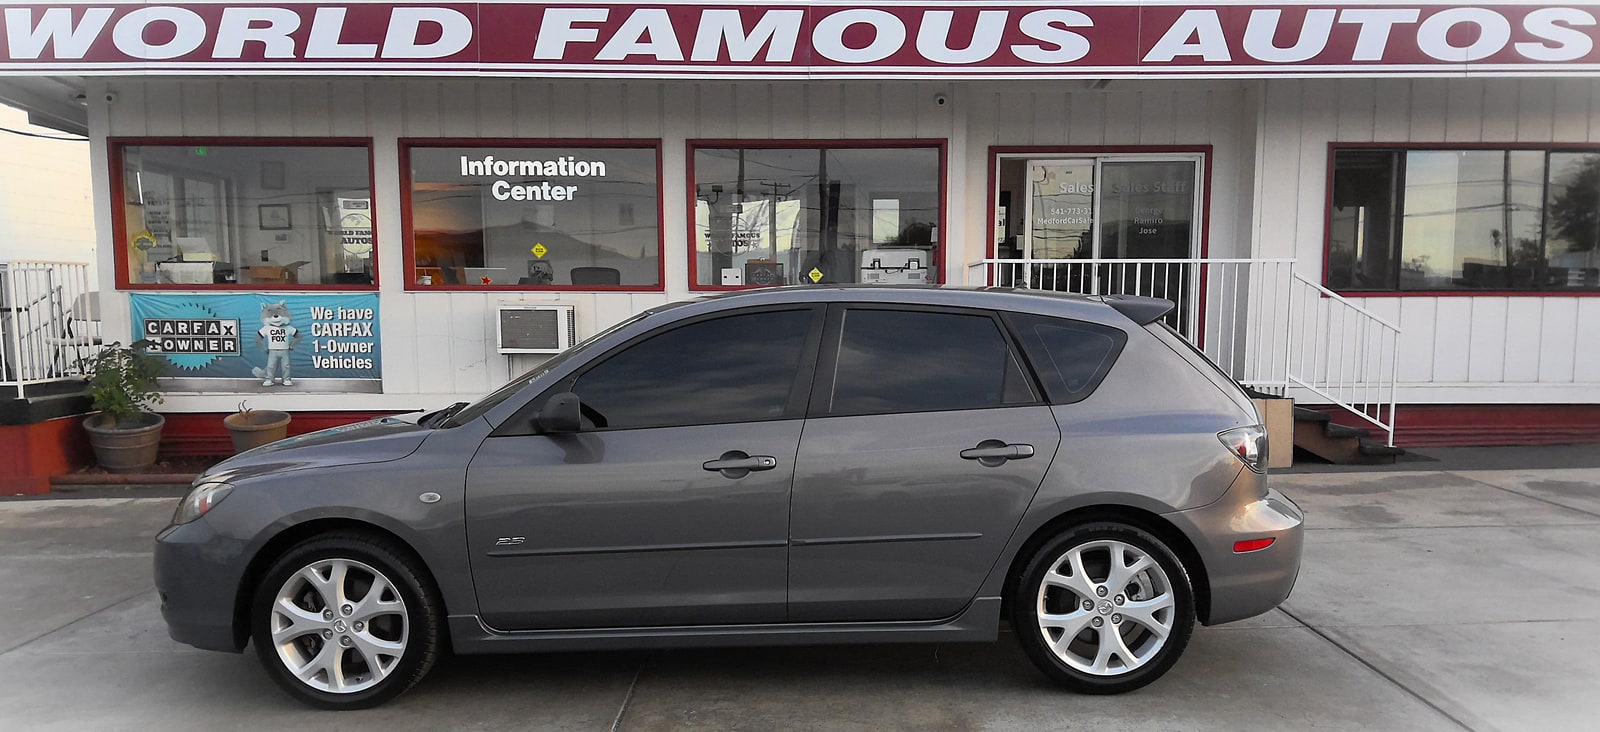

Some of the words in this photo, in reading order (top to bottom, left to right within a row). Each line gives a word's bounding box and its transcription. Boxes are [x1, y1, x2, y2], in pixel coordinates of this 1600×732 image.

[5, 6, 474, 60] WORLD
[533, 7, 1093, 64] FAMOUS
[1141, 7, 1598, 63] AUTOS
[460, 155, 606, 177] Information
[492, 180, 578, 201] Center
[1059, 181, 1095, 194] Sales
[1111, 181, 1149, 194] Sales
[1153, 180, 1186, 193] Staff
[1134, 217, 1163, 225] Ramiro
[1138, 227, 1157, 235] Jose
[310, 306, 336, 320] We
[338, 306, 374, 320] have
[147, 321, 235, 336] CARFAX
[269, 328, 287, 336] CAR
[310, 322, 373, 337] CARFAX
[271, 335, 286, 343] FOX
[312, 340, 374, 354] 1-Owner
[311, 355, 373, 369] Vehicles
